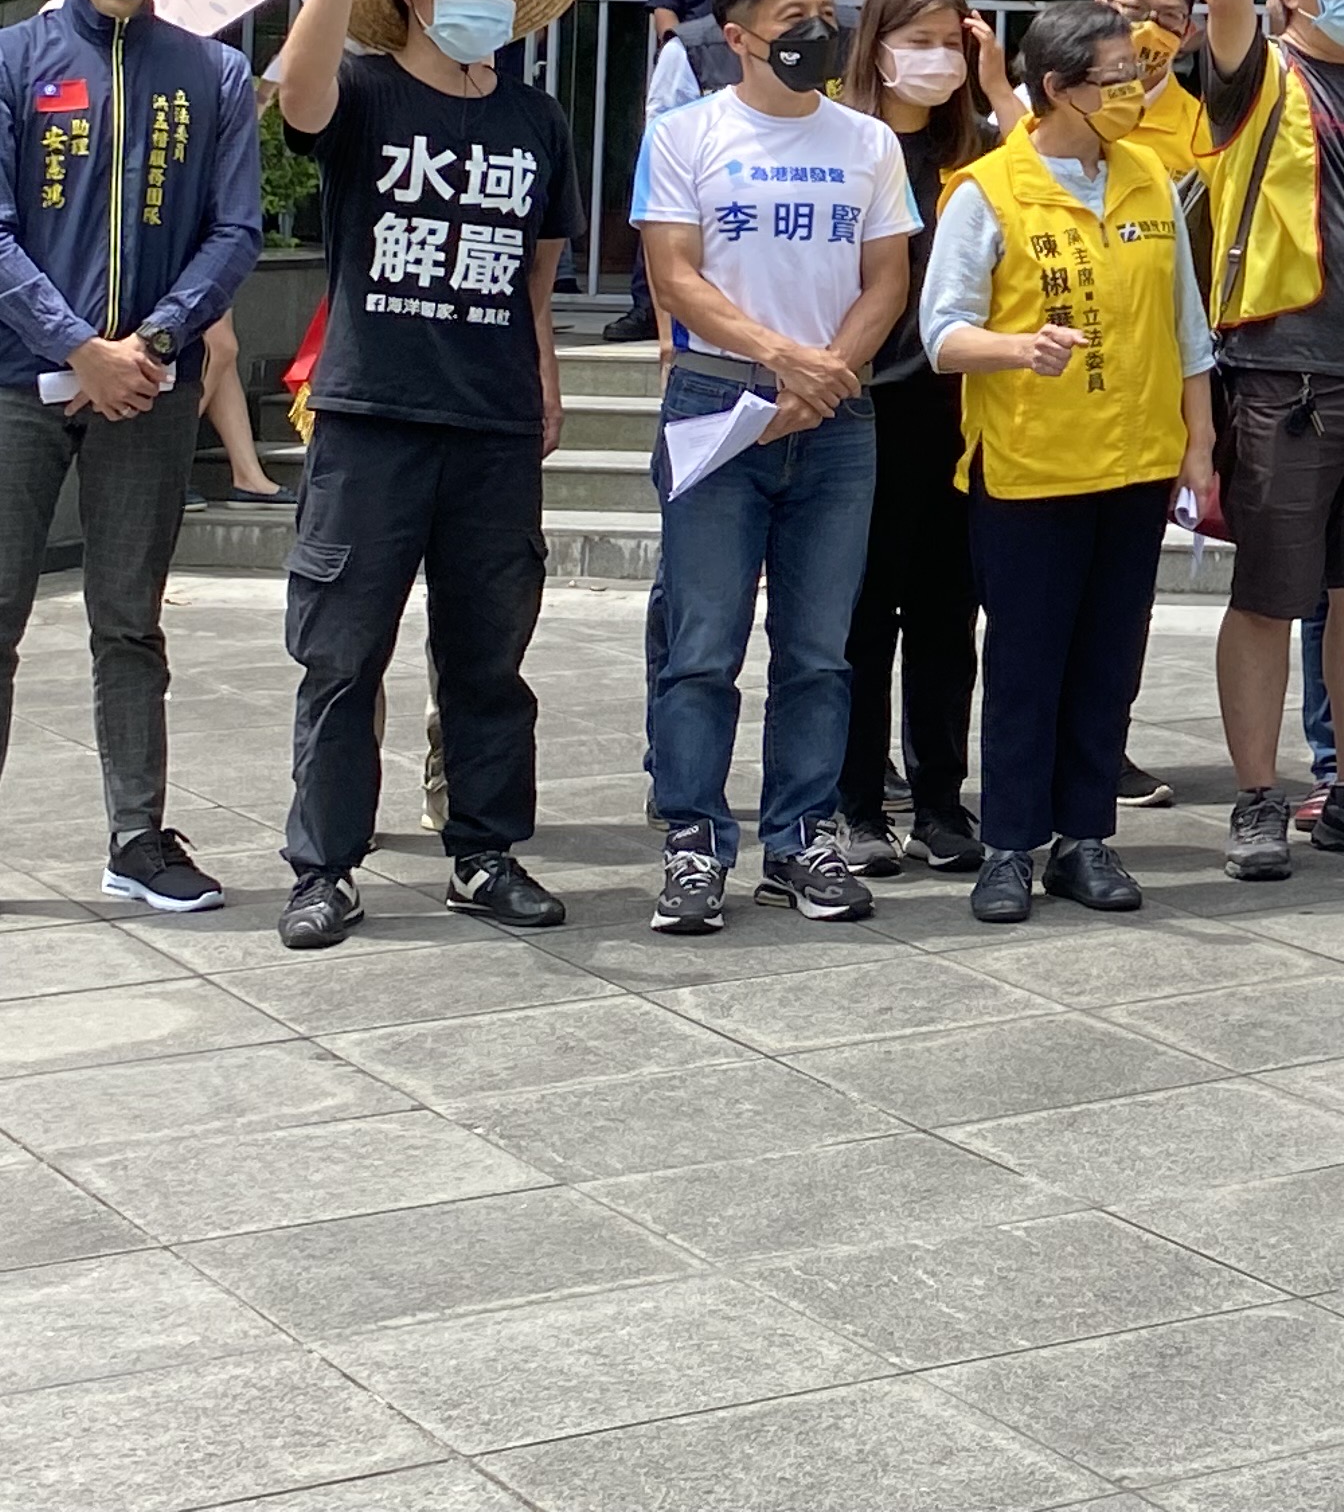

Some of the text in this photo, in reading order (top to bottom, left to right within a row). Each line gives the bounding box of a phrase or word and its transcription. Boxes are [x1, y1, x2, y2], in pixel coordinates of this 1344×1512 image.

[376, 134, 538, 219] 水域
[750, 166, 846, 184] 為港湖發聲
[368, 211, 525, 297] 解嚴
[714, 200, 862, 245] 李明賢
